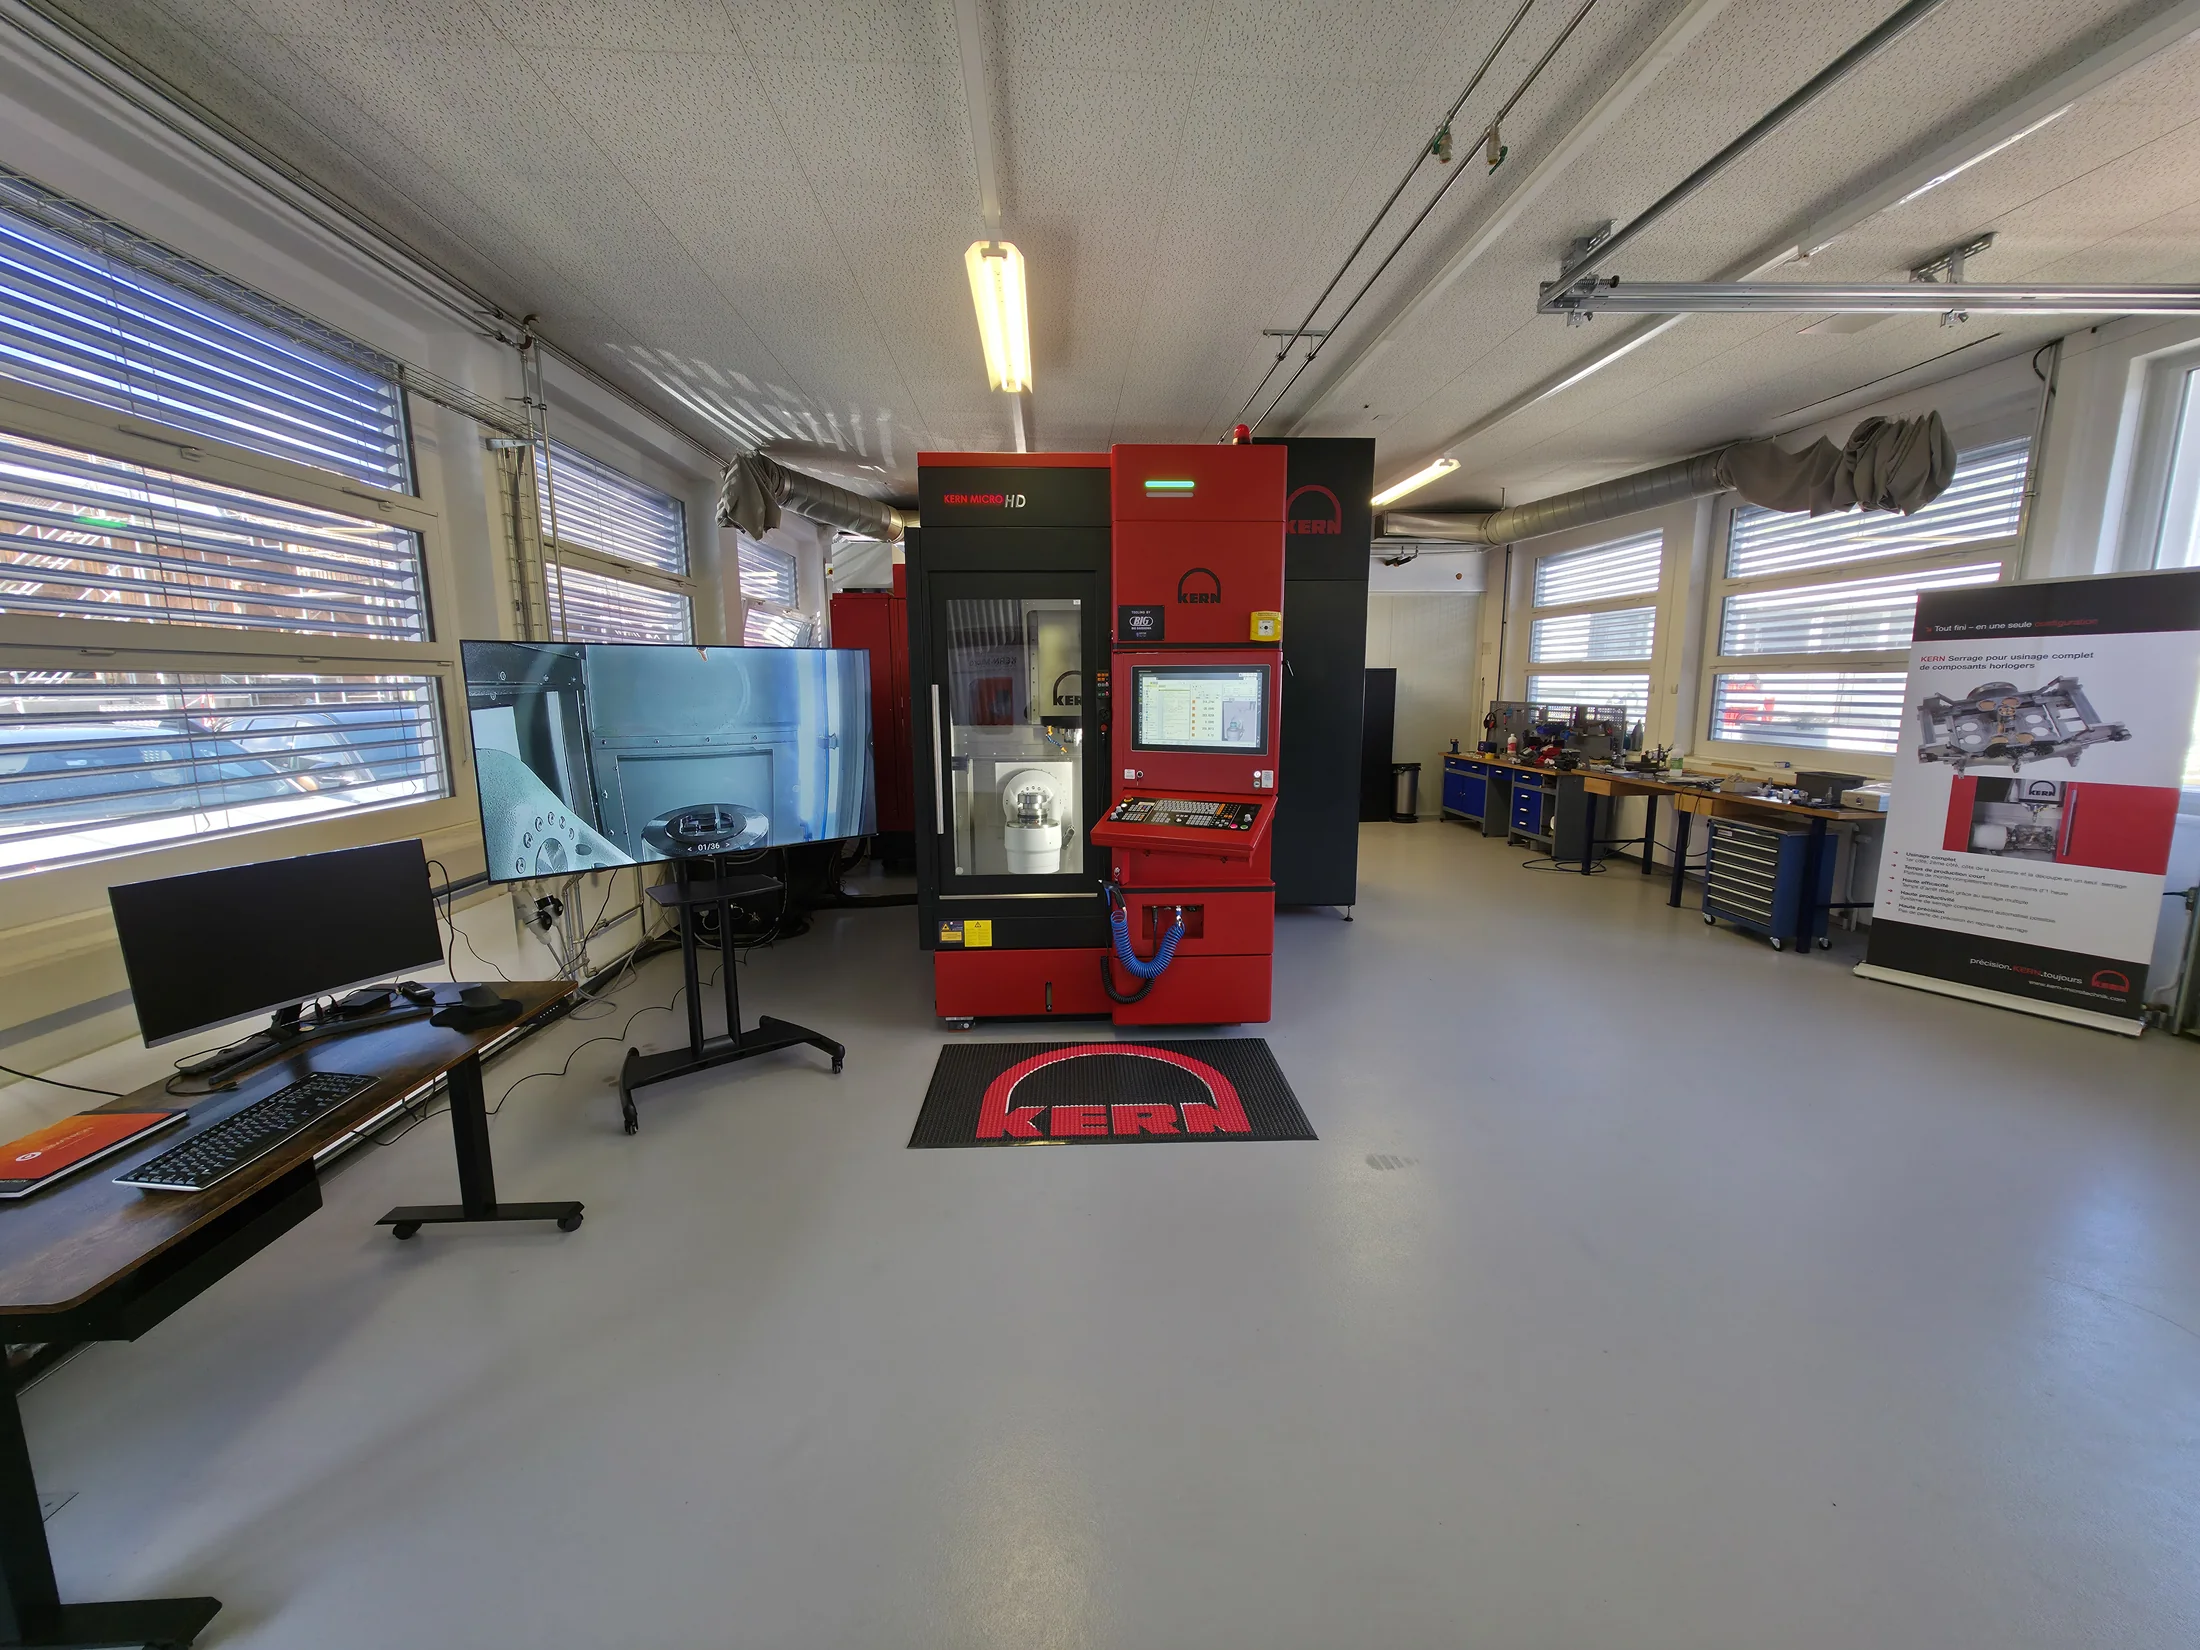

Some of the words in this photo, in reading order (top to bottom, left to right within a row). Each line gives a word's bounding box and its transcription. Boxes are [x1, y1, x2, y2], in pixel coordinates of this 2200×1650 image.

[943, 494, 969, 504] KERN
[970, 494, 1004, 504] MICRO
[1004, 494, 1027, 508] HD
[1286, 519, 1342, 535] KERN
[1177, 593, 1221, 604] KERN
[1133, 616, 1149, 625] BIG
[2007, 621, 2033, 629] seule
[1920, 655, 1946, 663] KERN
[1947, 654, 1984, 664] Serrage
[1985, 654, 2009, 662] pour
[2010, 653, 2050, 662] usinage
[2051, 652, 2094, 661] complet
[1932, 663, 1988, 672] composants
[1989, 662, 2036, 671] horlogers
[1052, 695, 1081, 706] KER
[697, 842, 720, 852] 01/36
[1934, 869, 1967, 877] production
[976, 1102, 1252, 1138] KERN
